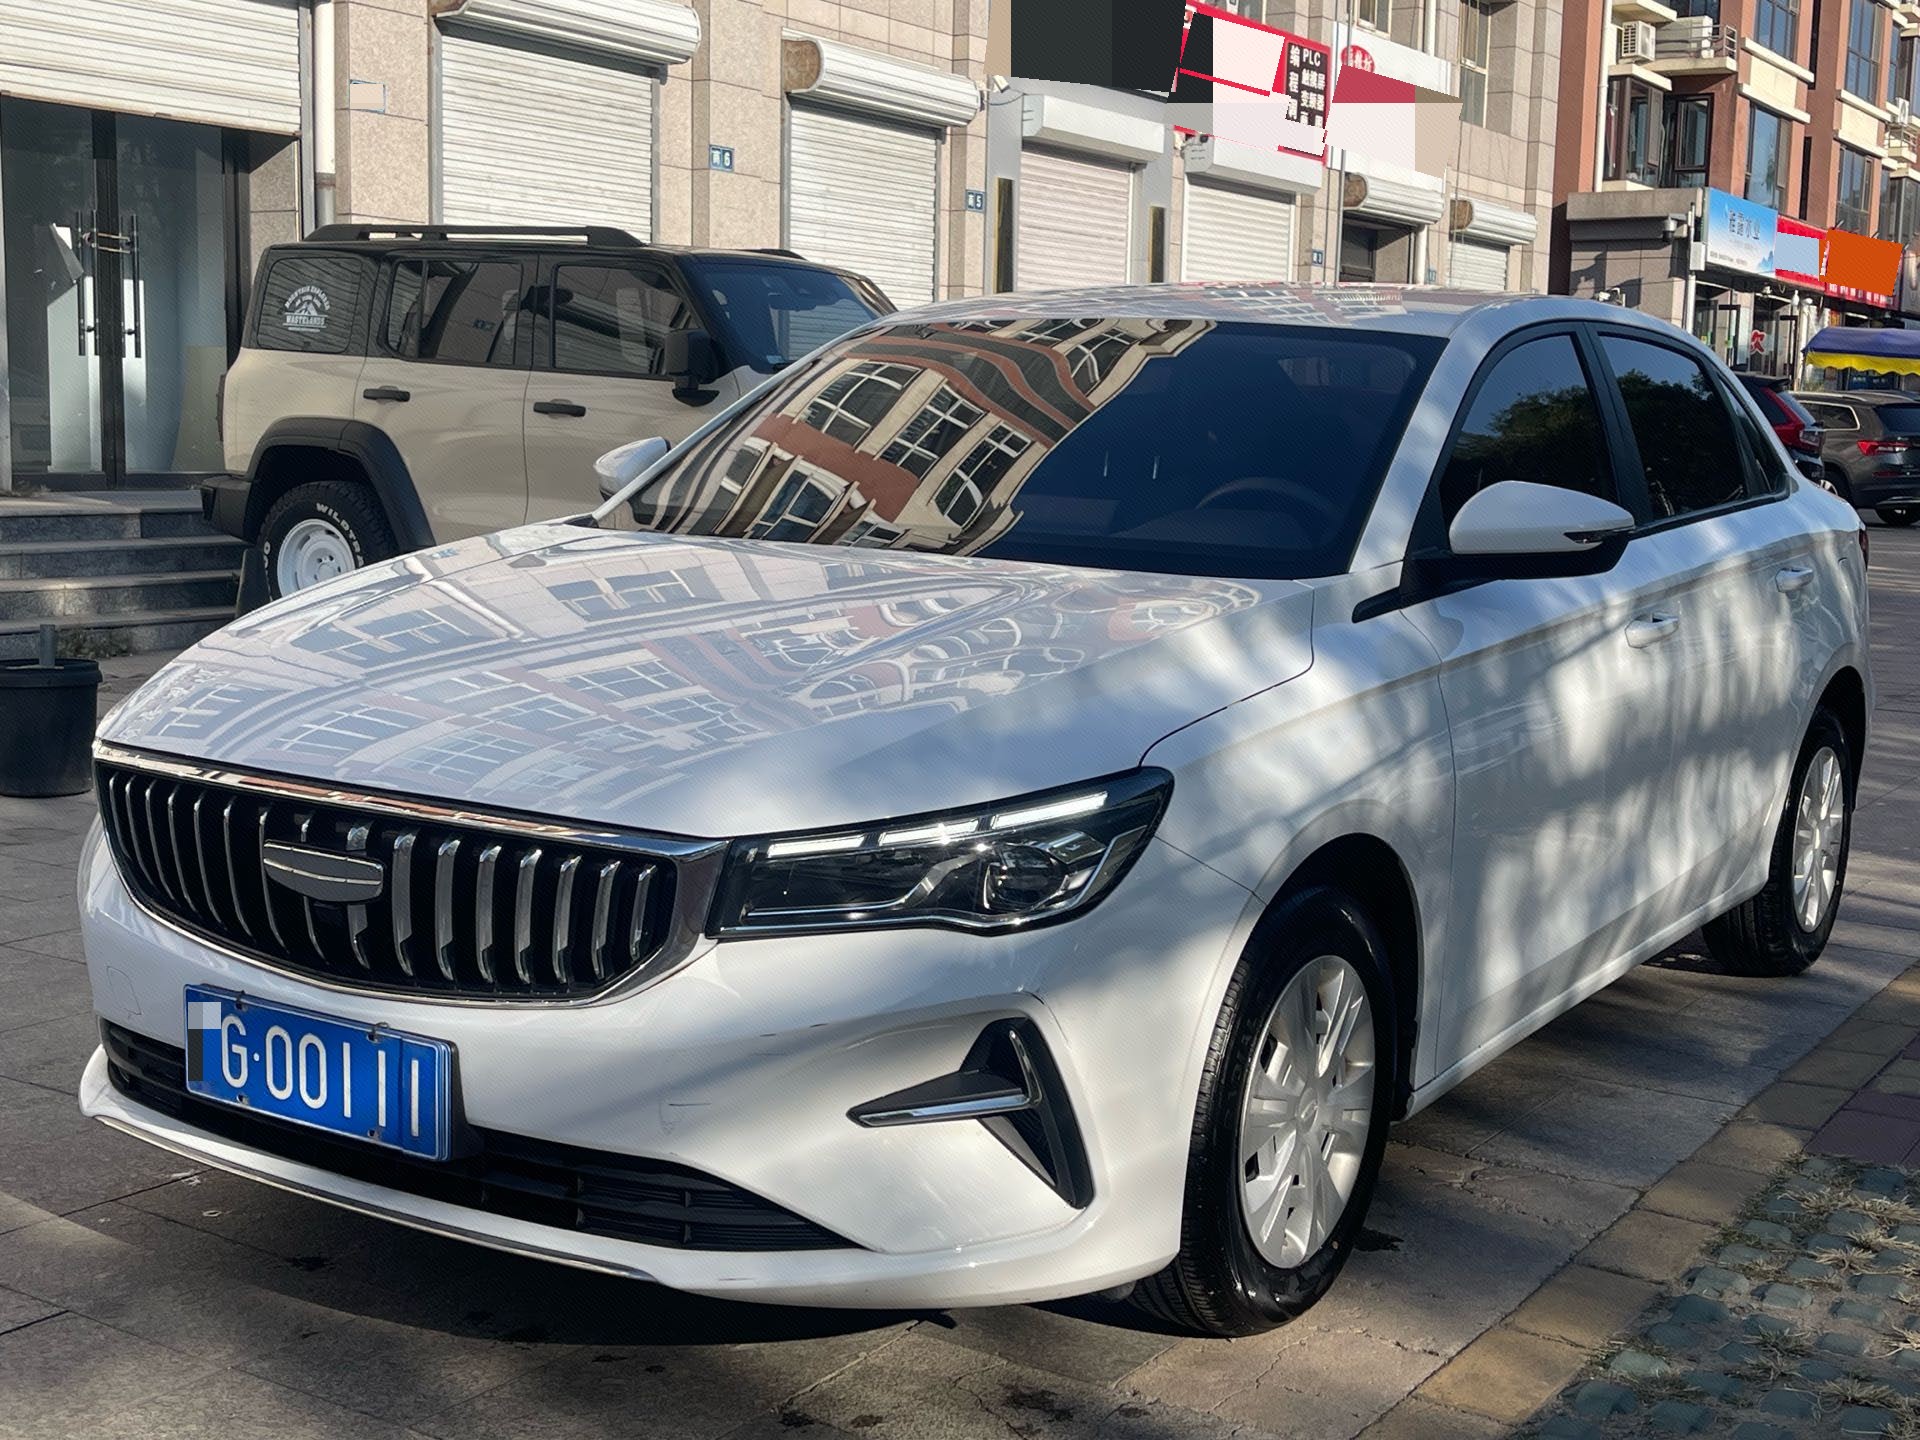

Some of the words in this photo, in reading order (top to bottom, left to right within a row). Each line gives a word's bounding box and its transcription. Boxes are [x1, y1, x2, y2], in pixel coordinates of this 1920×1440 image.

[1302, 48, 1321, 67] PLC
[286, 314, 326, 326] WASTELANDS
[190, 1004, 420, 1138] G·00111
